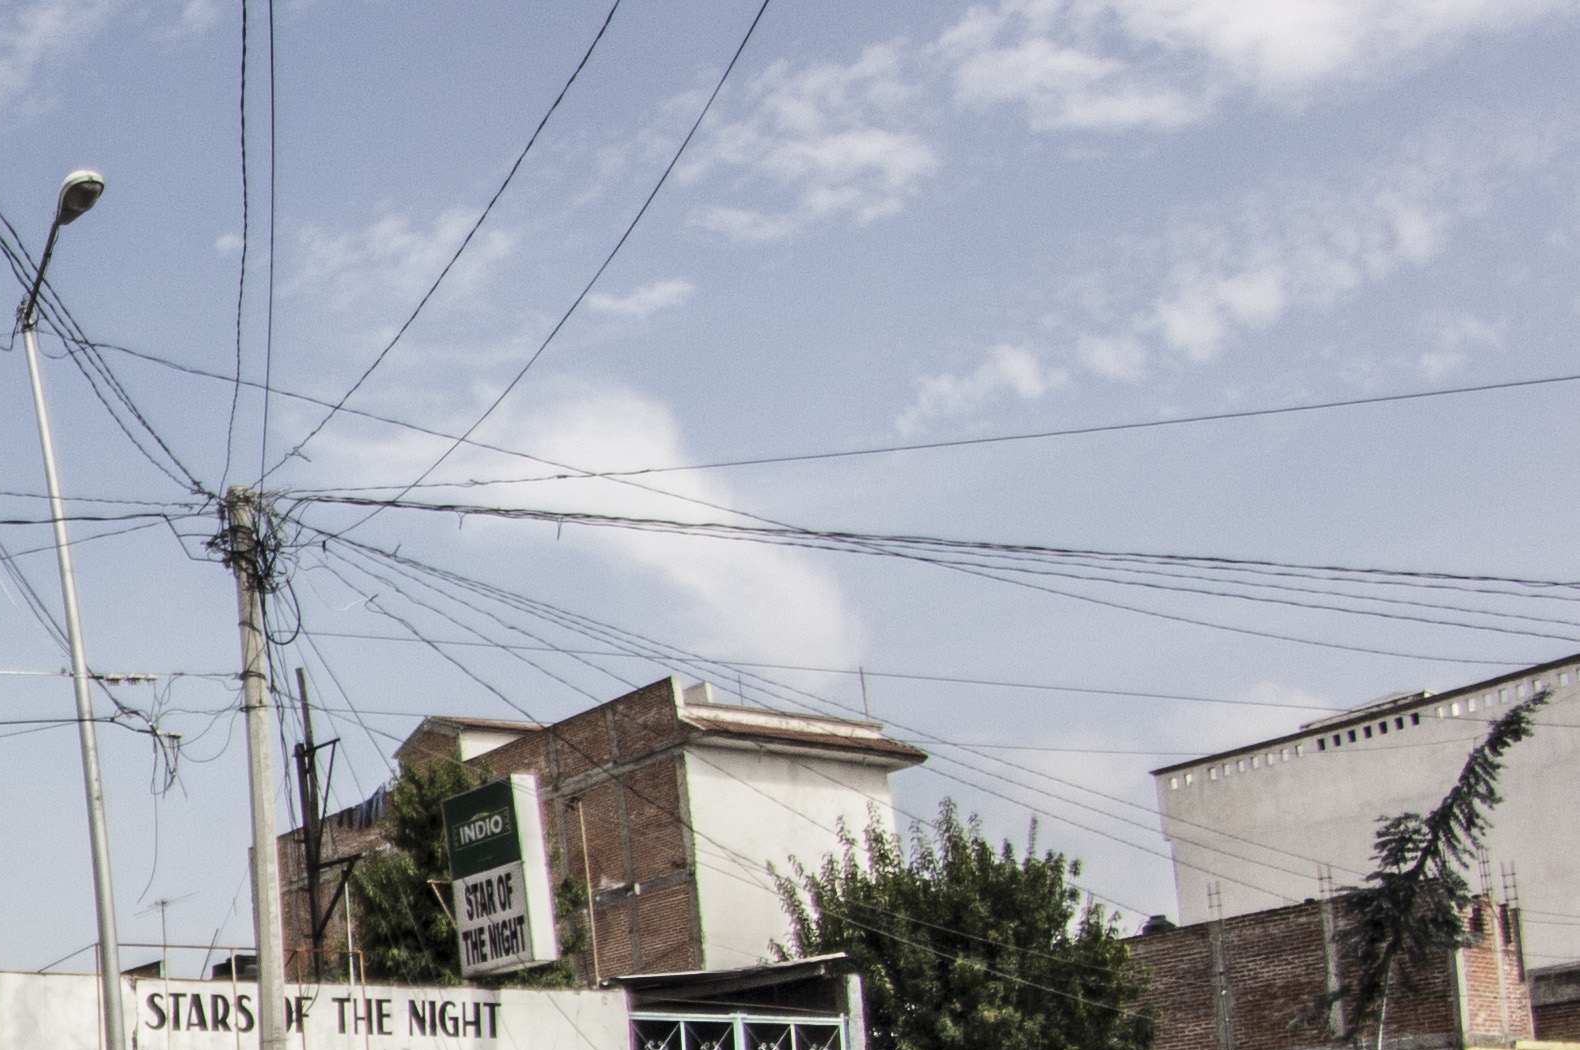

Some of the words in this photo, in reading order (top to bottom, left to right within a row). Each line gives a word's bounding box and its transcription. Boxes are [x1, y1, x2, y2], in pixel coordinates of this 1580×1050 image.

[459, 815, 503, 845] INDIO
[465, 878, 497, 921] STAR
[496, 872, 513, 912] OF
[462, 927, 488, 966] THE
[488, 915, 526, 960] NIGHT
[144, 992, 255, 1033] STARS
[285, 996, 313, 1034] F
[331, 997, 393, 1036] THE
[408, 999, 502, 1039] NIGHT
